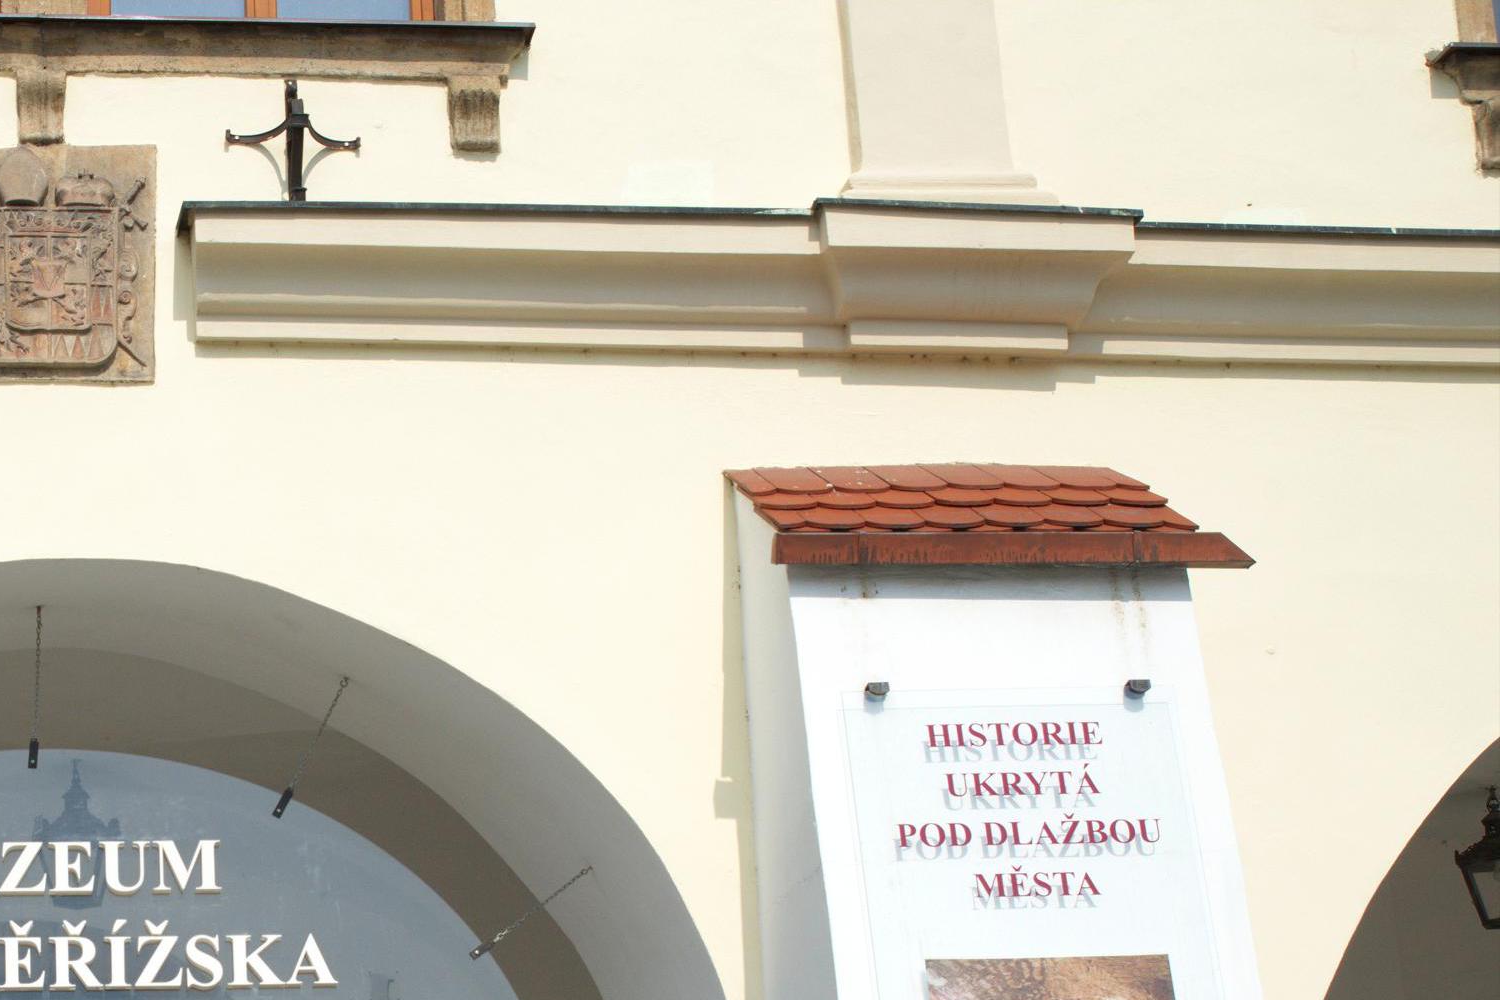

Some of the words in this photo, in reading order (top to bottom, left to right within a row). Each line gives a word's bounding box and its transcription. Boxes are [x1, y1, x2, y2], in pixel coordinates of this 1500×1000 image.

[924, 721, 1103, 748] HISTORIE
[943, 763, 1101, 798] UKRYTÁ
[897, 822, 972, 848] POD
[984, 813, 1161, 846] DLAŽBOU
[974, 865, 1102, 898] MĚSTA
